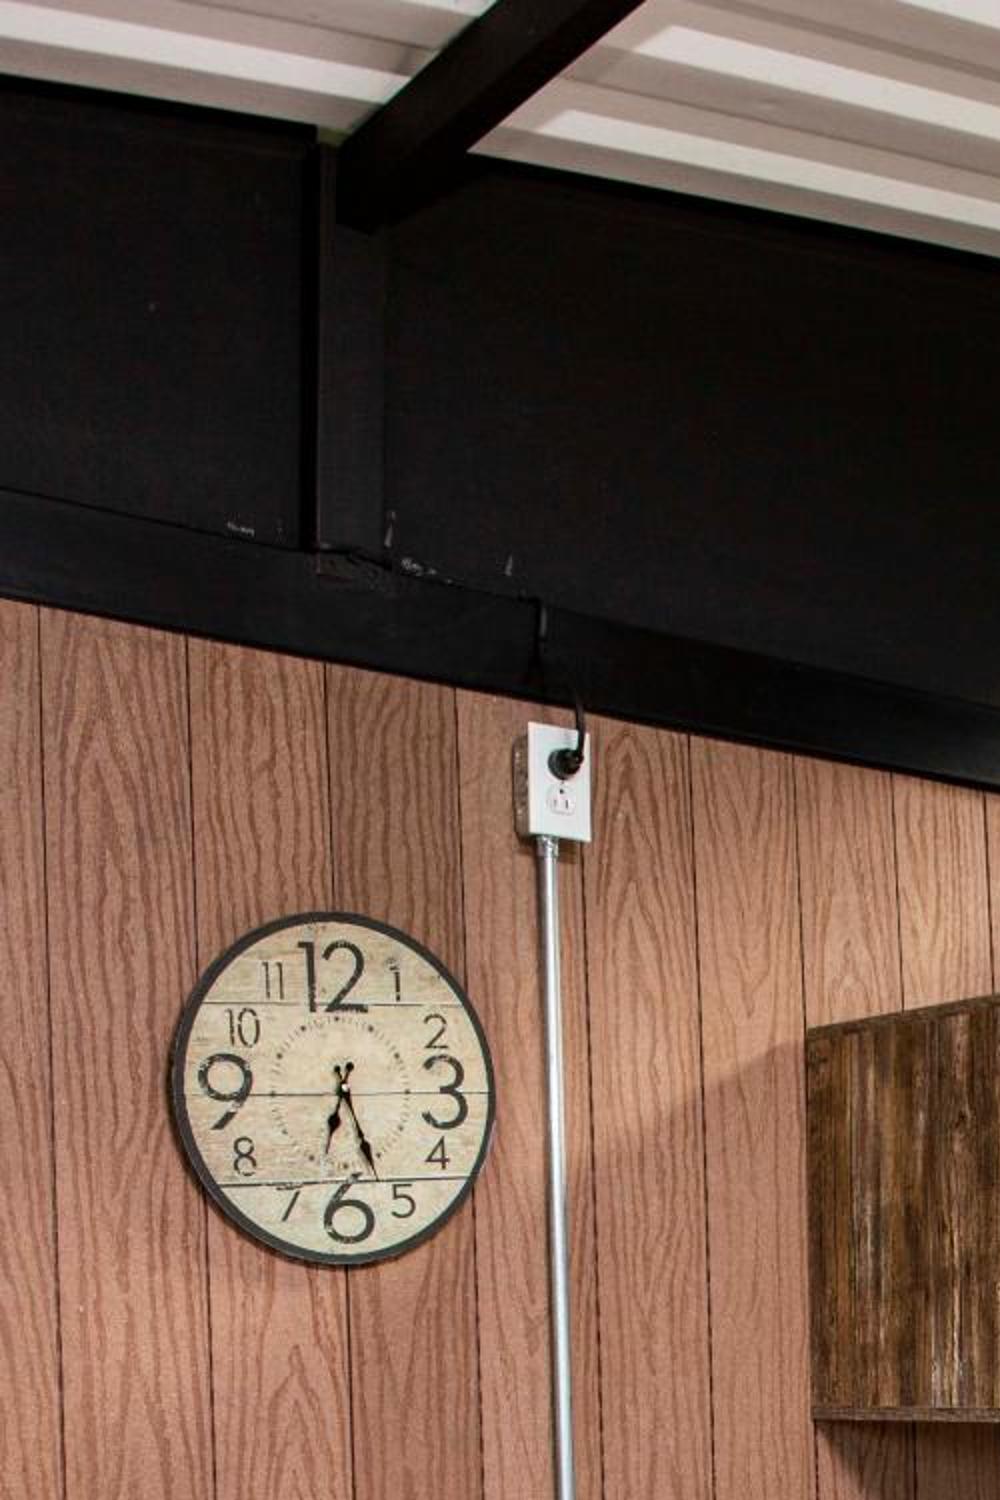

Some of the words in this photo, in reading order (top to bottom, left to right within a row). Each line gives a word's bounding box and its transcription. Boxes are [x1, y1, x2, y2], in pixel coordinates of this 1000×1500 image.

[261, 961, 284, 1000] 11
[297, 940, 369, 1013] 12
[389, 963, 402, 1002] 1
[226, 1007, 261, 1048] 10
[423, 1013, 449, 1049] 2
[198, 1053, 253, 1130] 9
[421, 1054, 468, 1130] 3
[233, 1136, 257, 1176] 8
[425, 1136, 450, 1170] 4
[275, 1183, 303, 1222] 7
[323, 1171, 375, 1244] 6
[391, 1183, 416, 1219] 5
